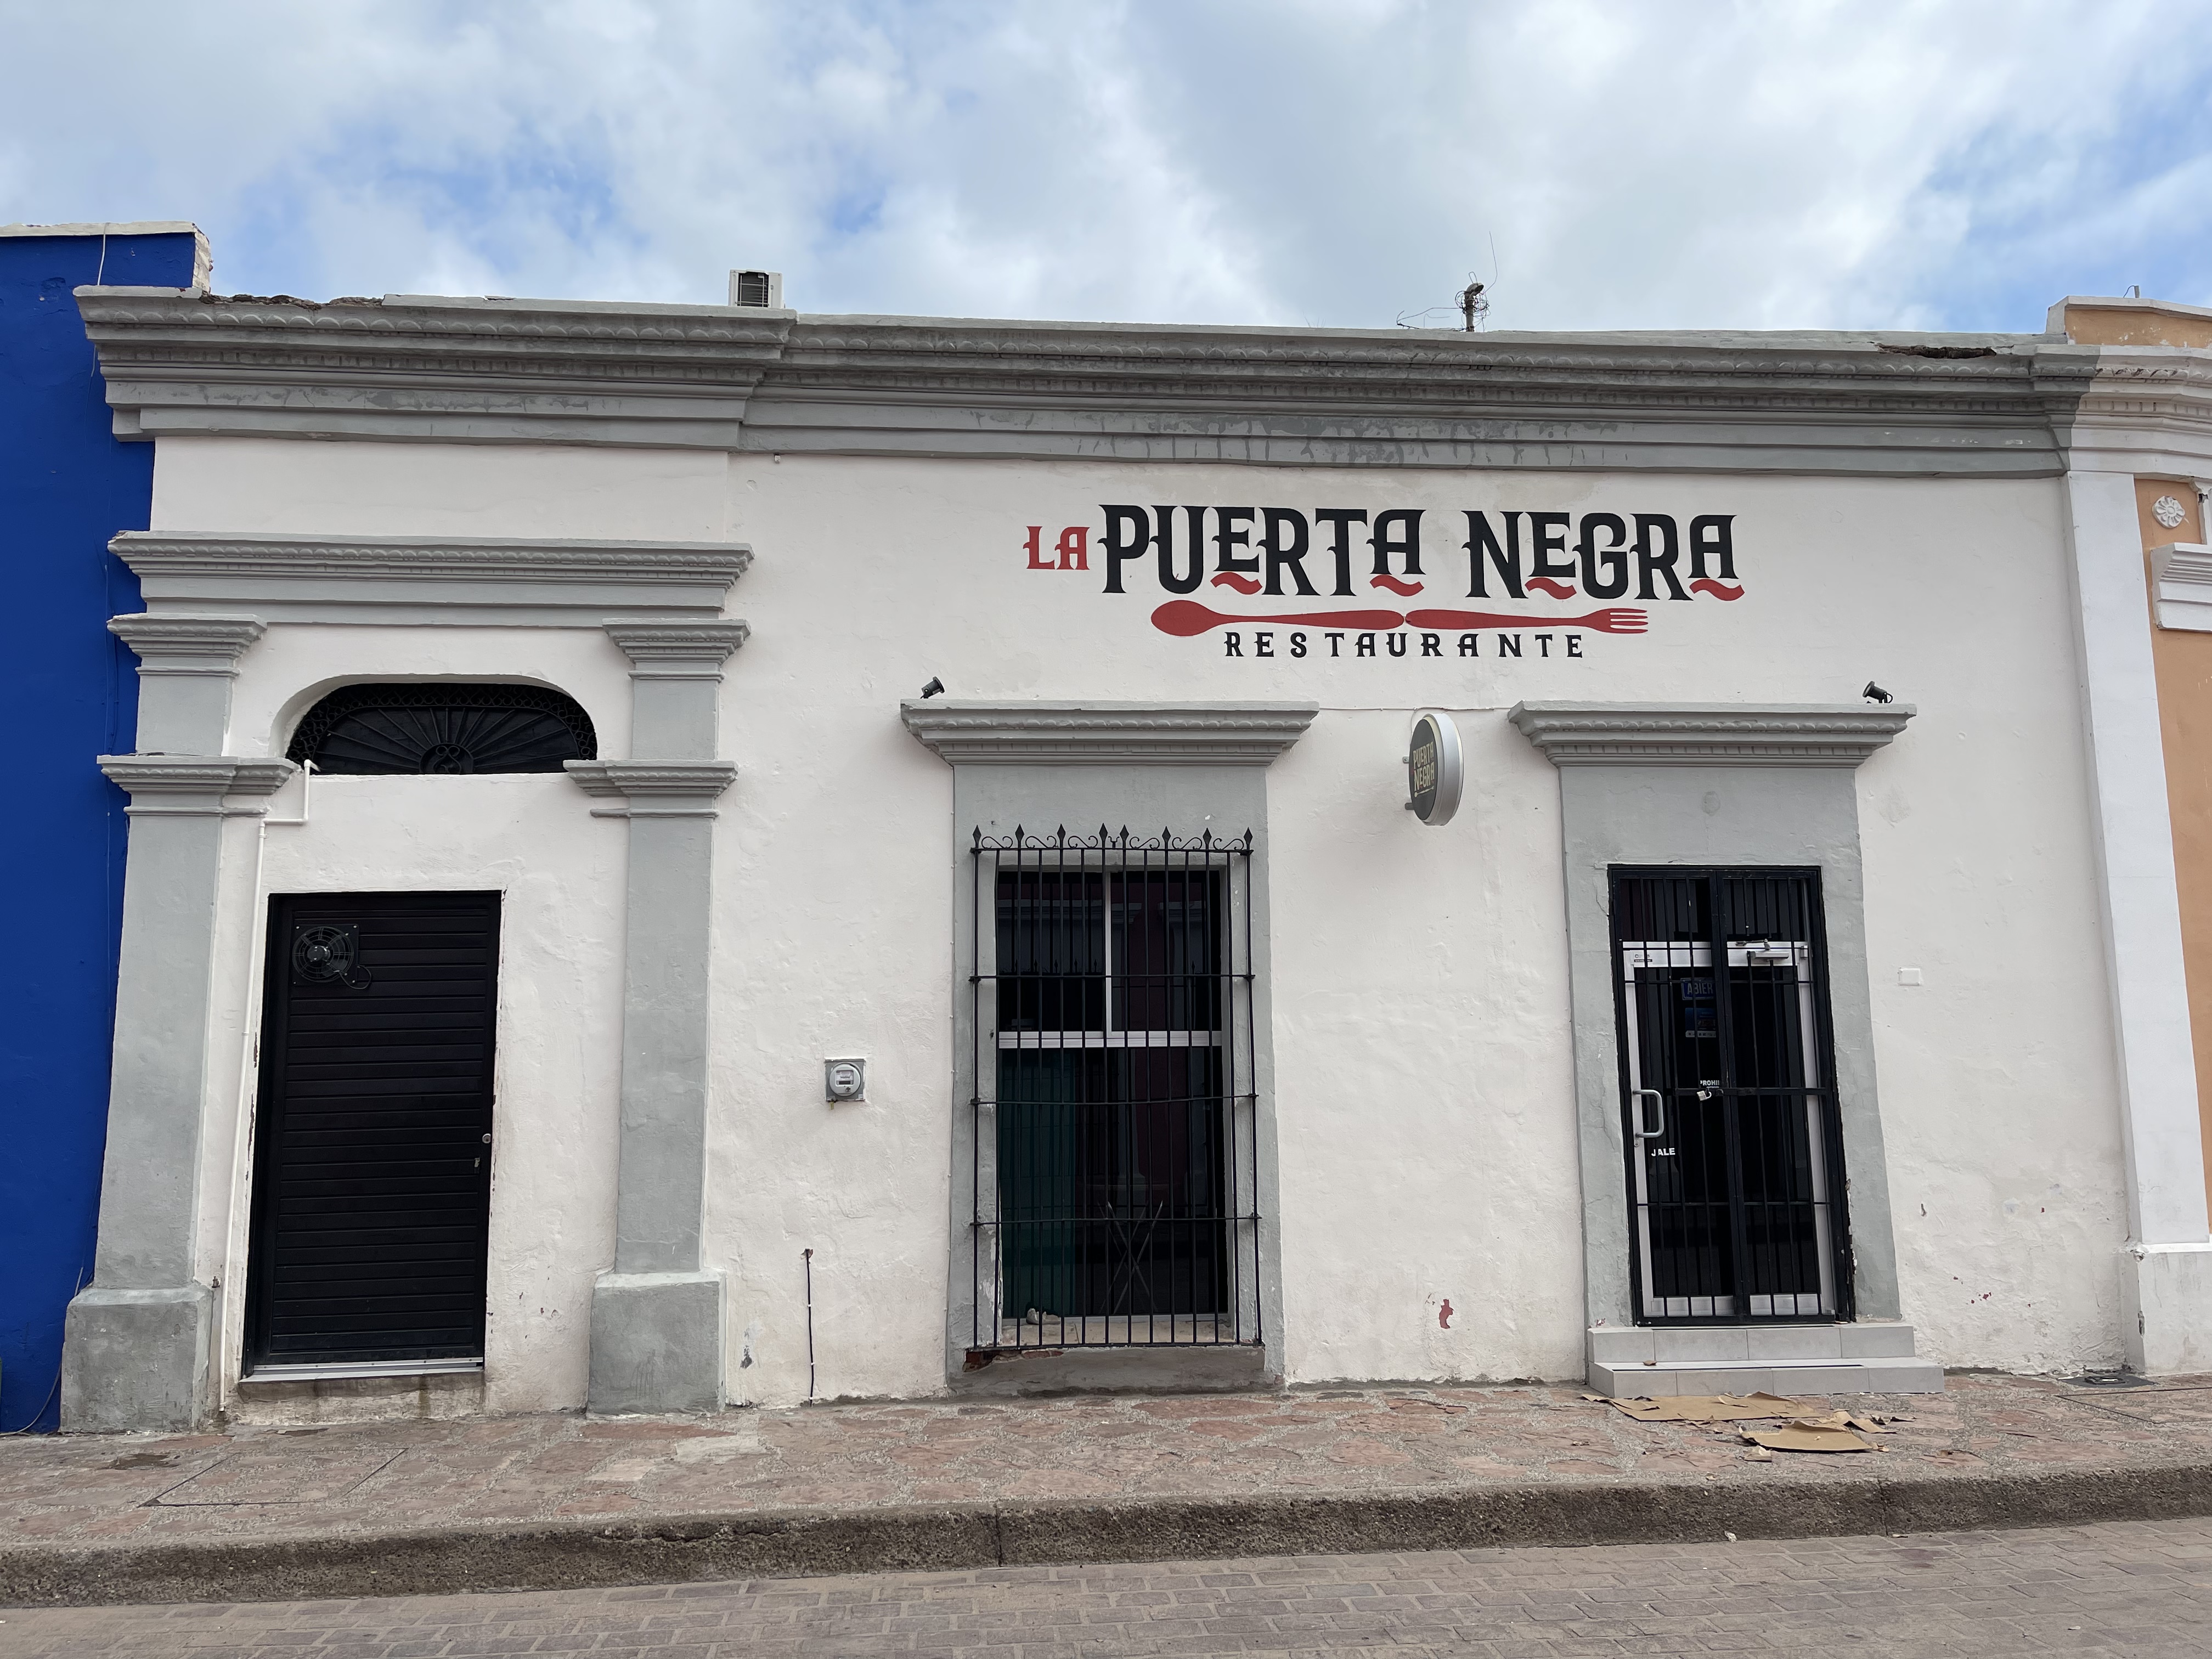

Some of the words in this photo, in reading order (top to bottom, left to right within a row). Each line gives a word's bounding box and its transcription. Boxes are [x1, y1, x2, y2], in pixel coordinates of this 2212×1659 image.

[1023, 526, 1091, 571] LA
[1097, 504, 1429, 598] PUERTA
[1461, 510, 1740, 601] NEGRA
[1224, 631, 1584, 659] RESTAURANTE
[1413, 741, 1434, 769] PUERTA
[1414, 761, 1435, 791] NEGRA
[1651, 1148, 1676, 1156] JALE
